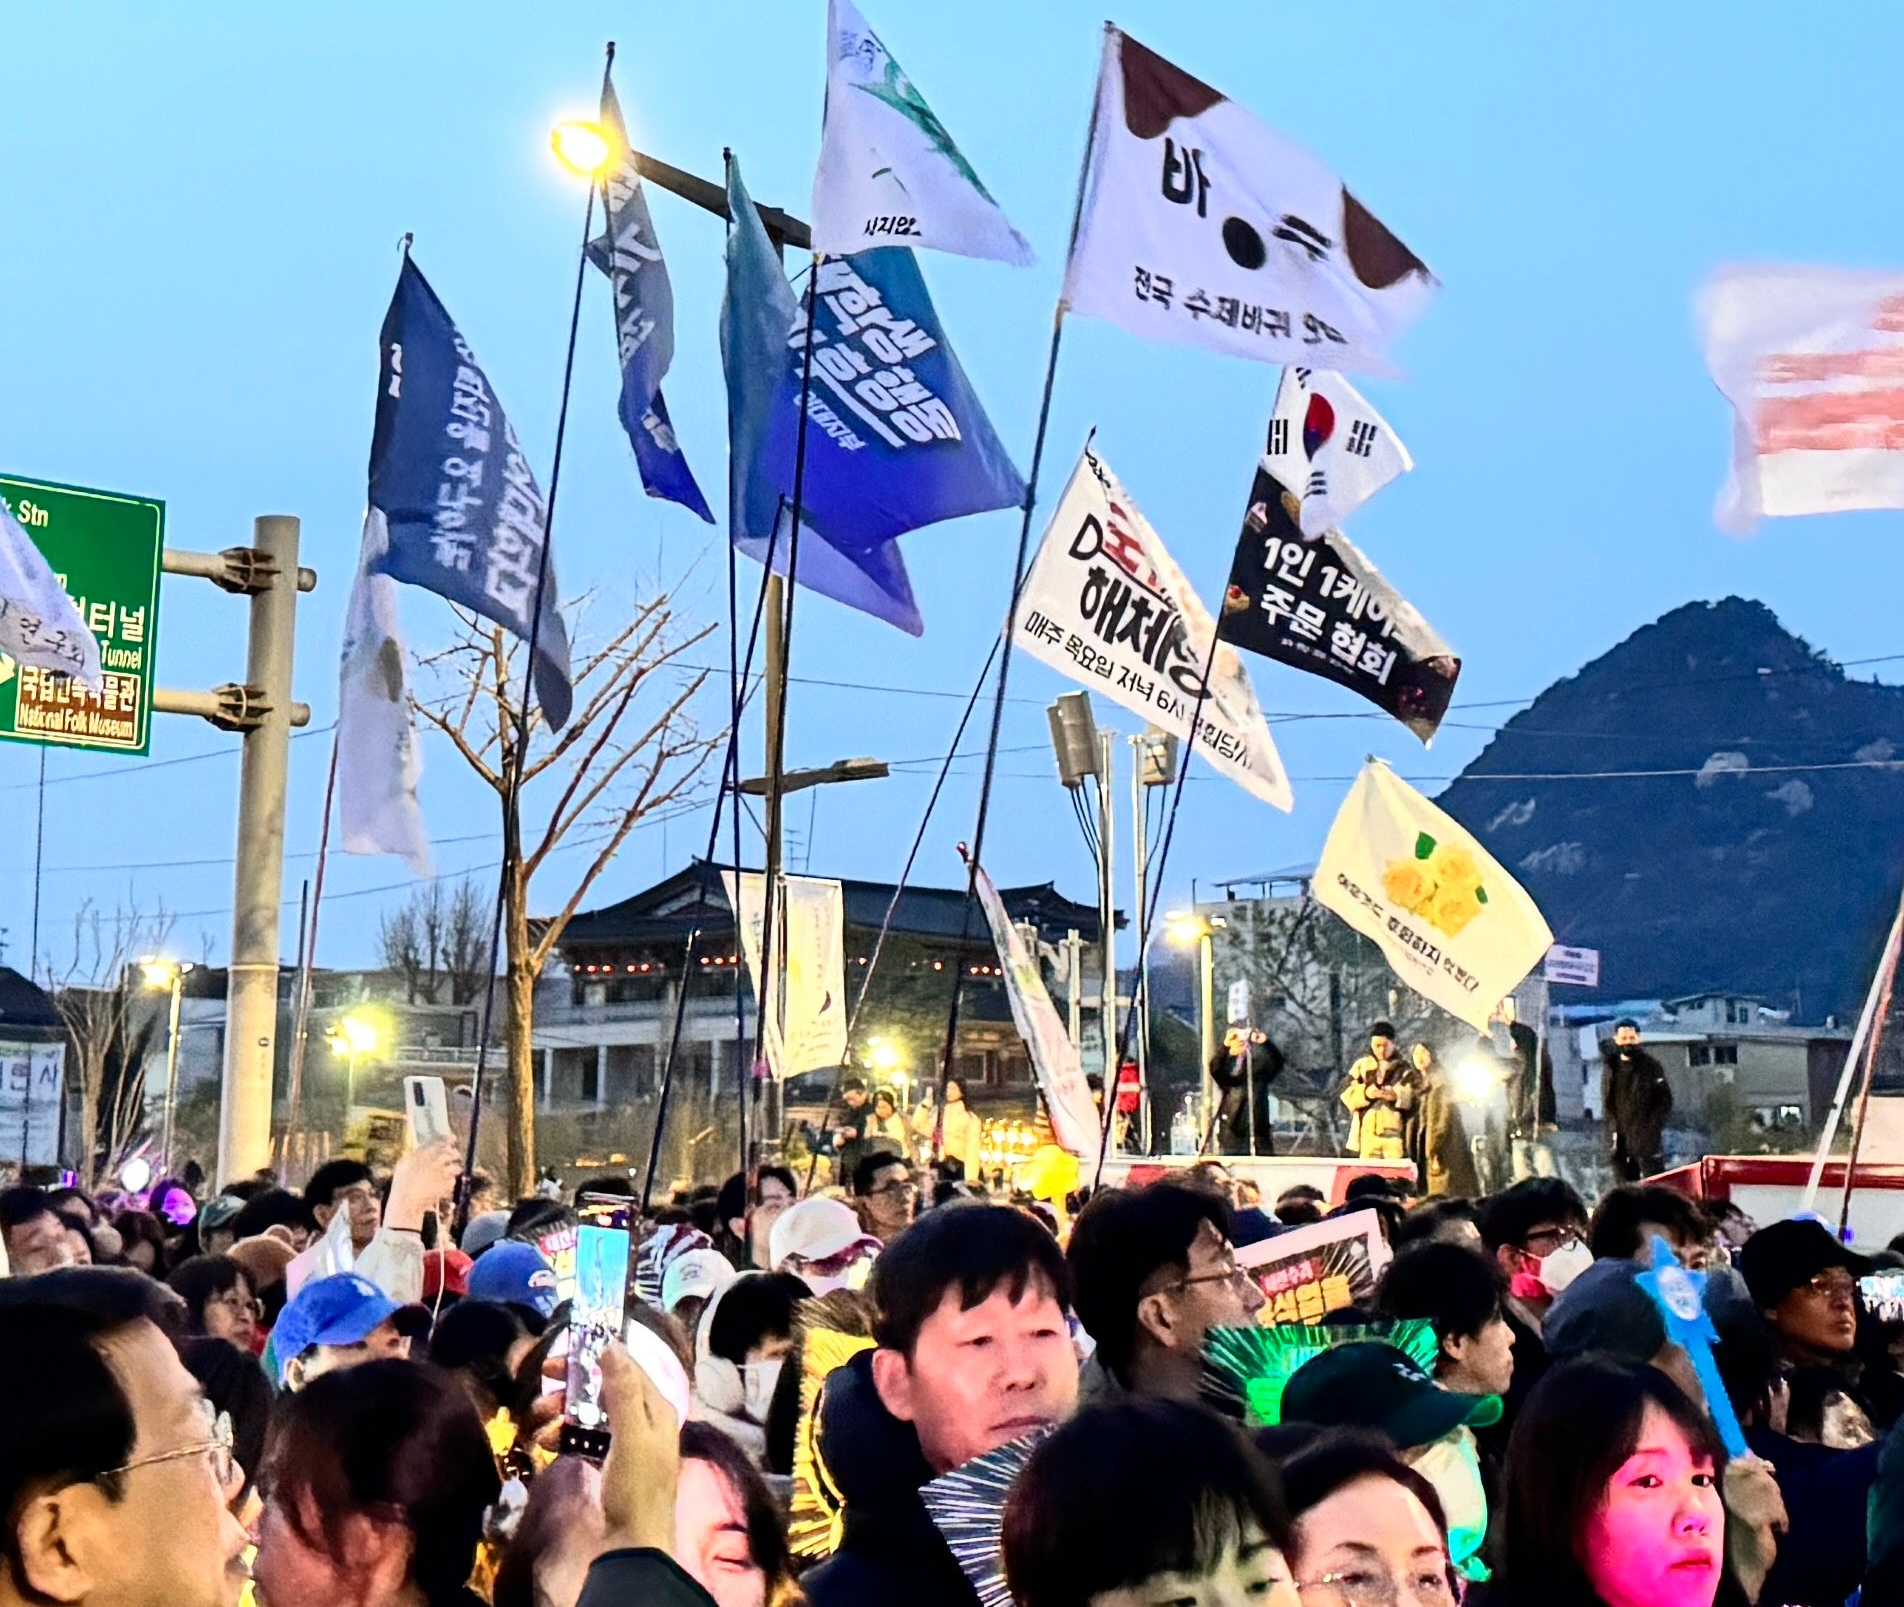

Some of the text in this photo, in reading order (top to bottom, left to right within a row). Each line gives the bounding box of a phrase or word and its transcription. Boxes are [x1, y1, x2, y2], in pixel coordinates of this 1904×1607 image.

[1134, 265, 1174, 311] 전국
[18, 499, 48, 527] Stn
[1263, 536, 1401, 640] 1인 1케이
[100, 640, 142, 669] Tunnel
[1025, 610, 1065, 645] 매주
[1065, 633, 1115, 678] 목요일
[1117, 665, 1154, 700] 저녁
[1260, 583, 1326, 641] 주문
[1330, 621, 1397, 686] 협회
[23, 666, 135, 712] 국립민속물관
[20, 703, 133, 738] National Folk Museum
